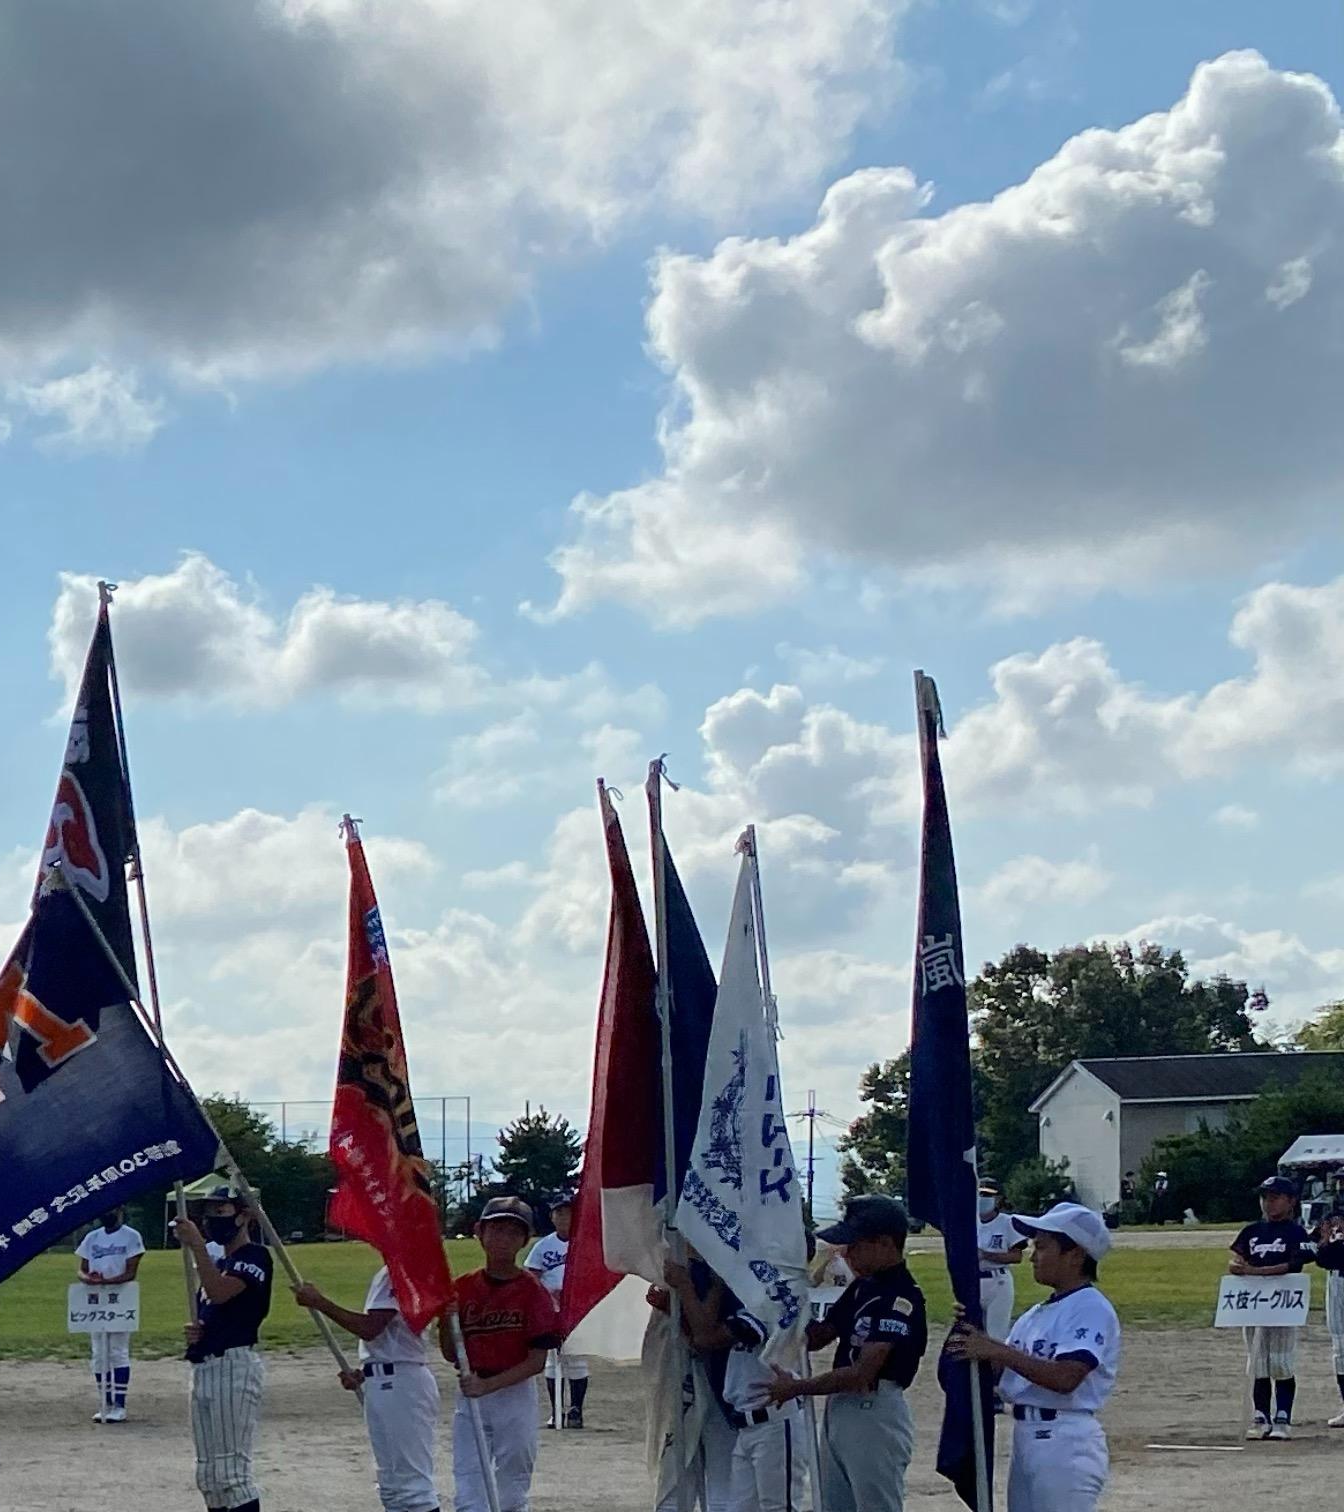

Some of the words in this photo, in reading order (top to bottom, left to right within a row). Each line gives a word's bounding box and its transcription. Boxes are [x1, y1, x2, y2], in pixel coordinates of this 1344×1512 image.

[1221, 1288, 1305, 1311] 大枝イーグルス
[69, 1308, 137, 1323] ビッグスターズ
